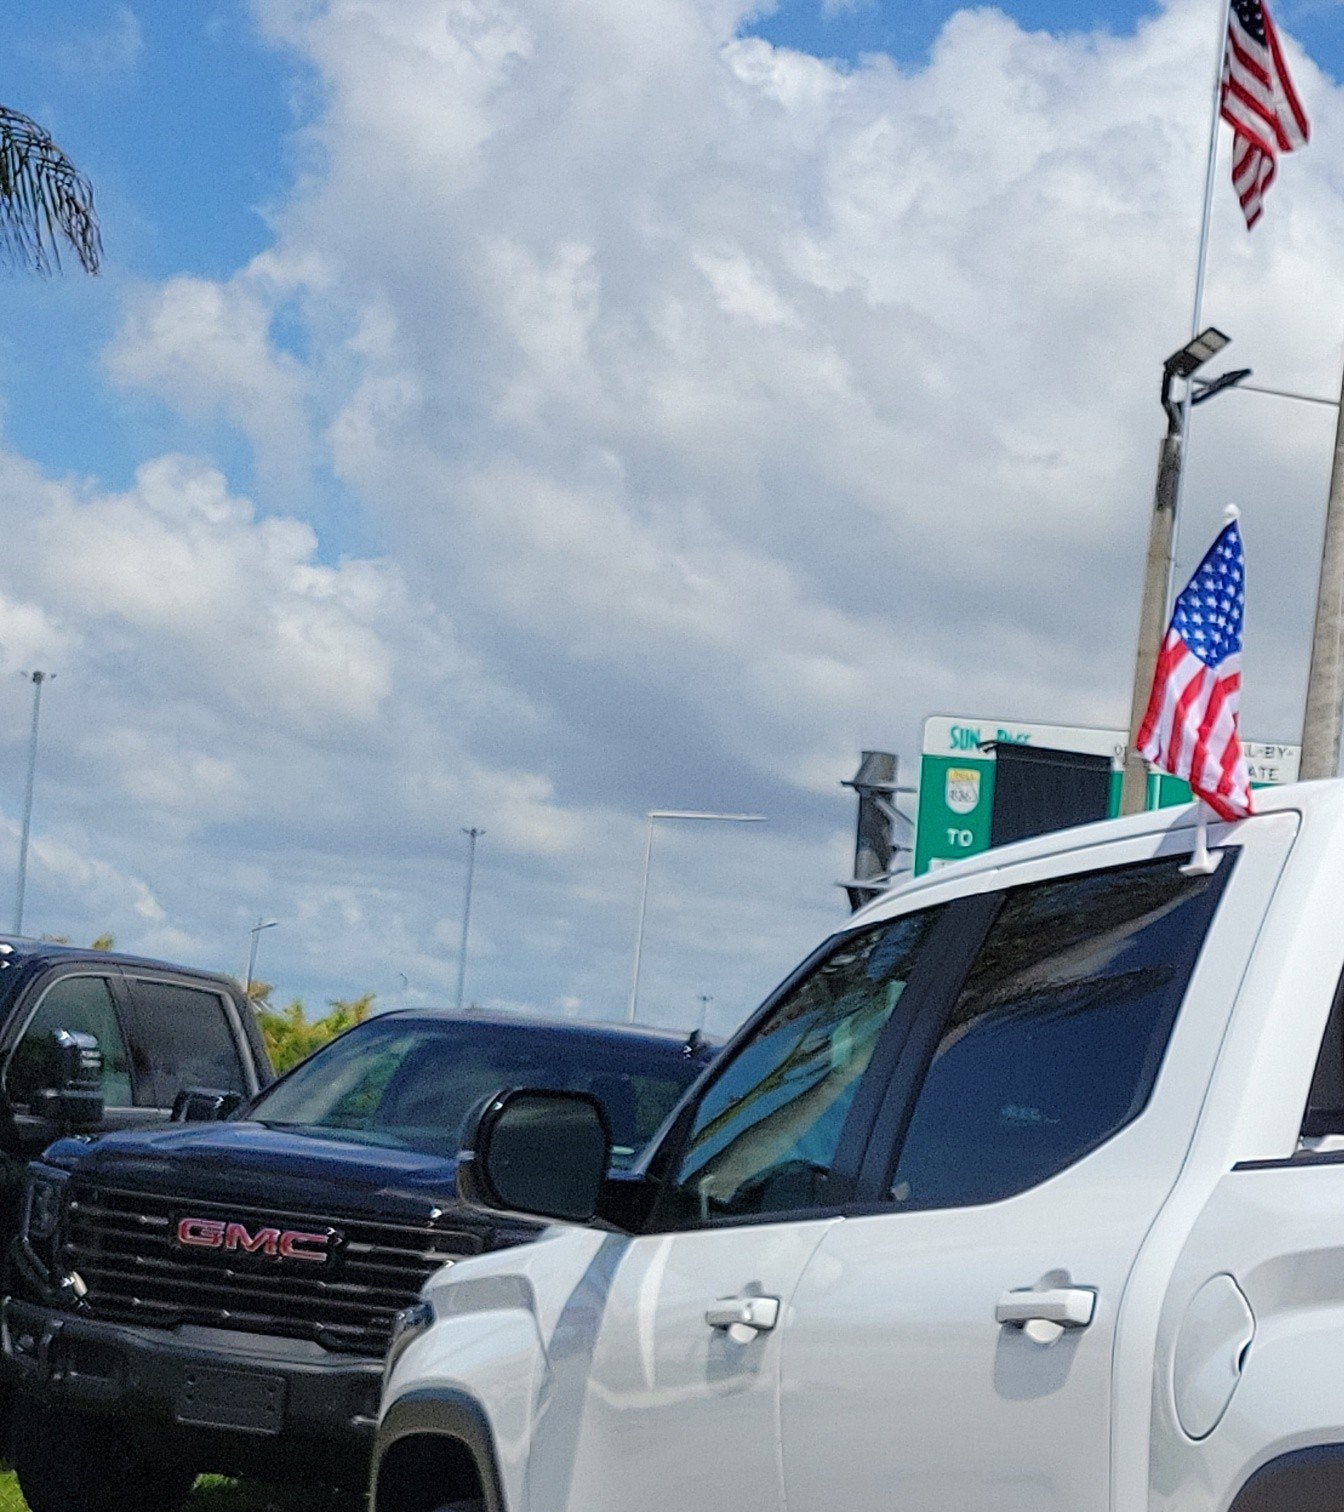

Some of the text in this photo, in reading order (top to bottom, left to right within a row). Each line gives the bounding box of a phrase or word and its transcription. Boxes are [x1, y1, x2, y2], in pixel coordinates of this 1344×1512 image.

[949, 725, 980, 750] SUN
[946, 828, 973, 847] TO
[177, 1217, 330, 1262] GMC
